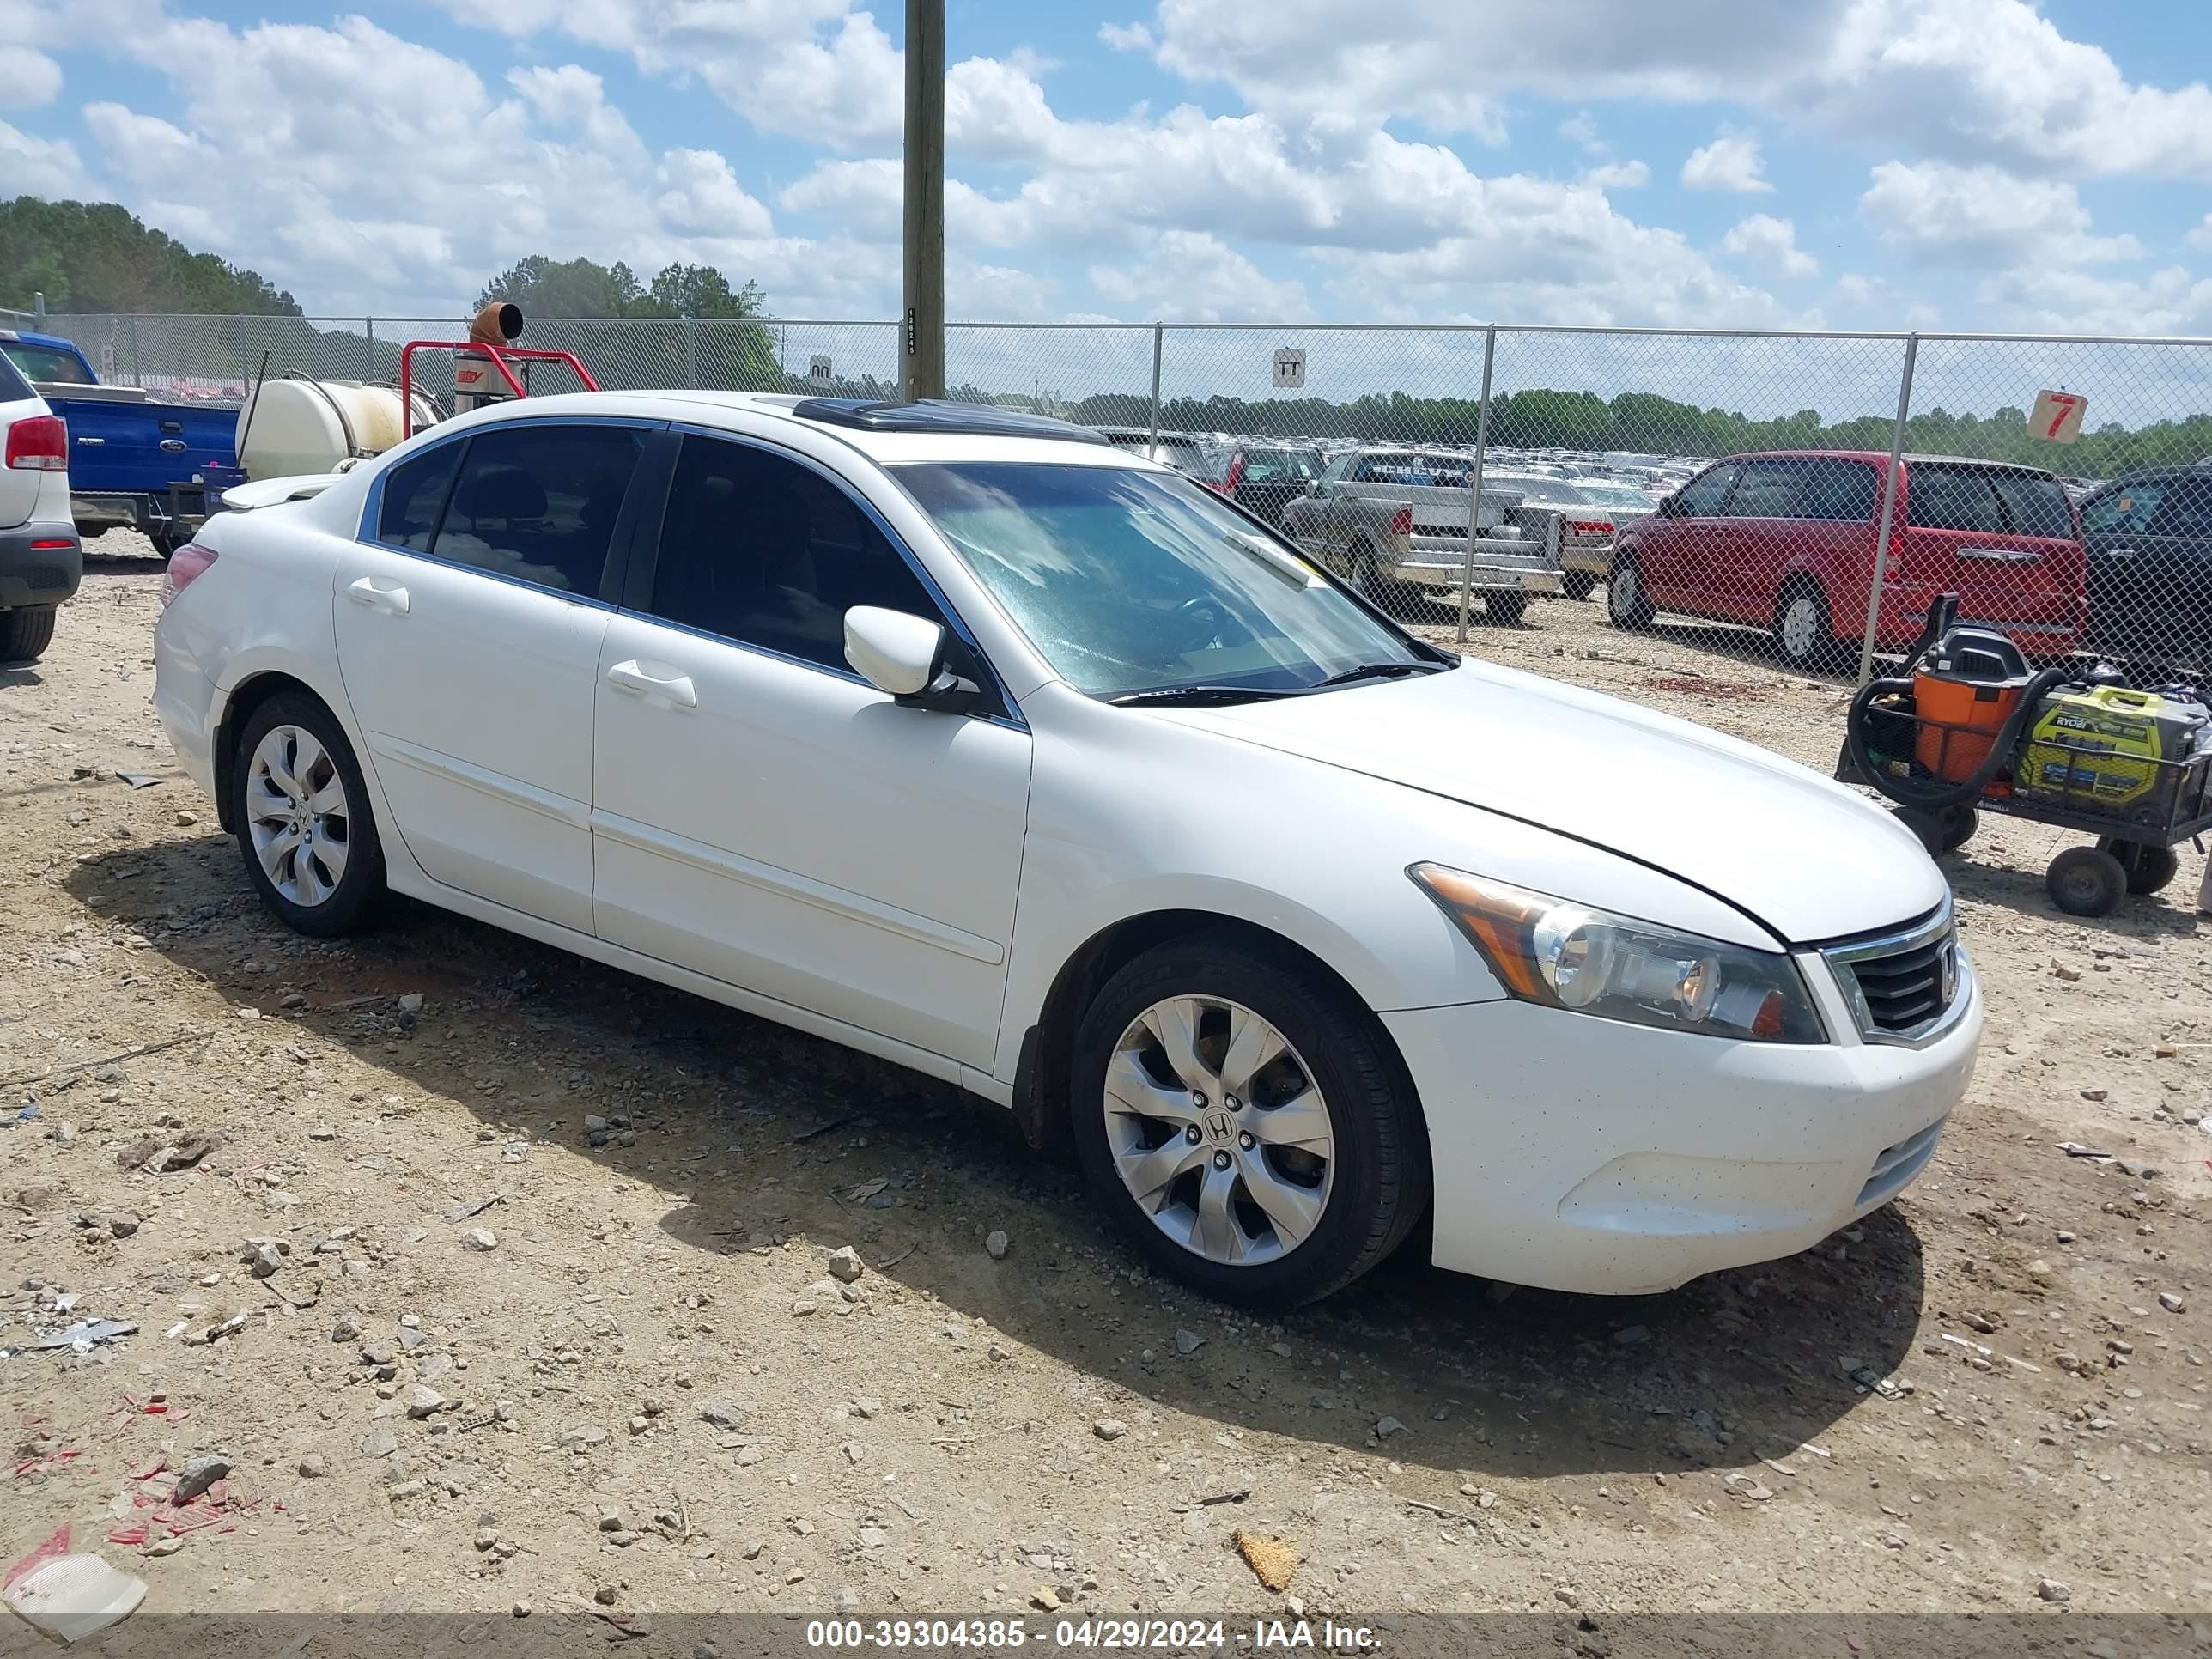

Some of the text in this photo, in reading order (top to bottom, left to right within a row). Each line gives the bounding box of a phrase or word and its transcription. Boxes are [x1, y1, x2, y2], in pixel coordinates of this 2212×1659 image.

[1279, 361, 1300, 375] TT
[2047, 394, 2076, 437] 7
[2056, 716, 2087, 729] RYOBI
